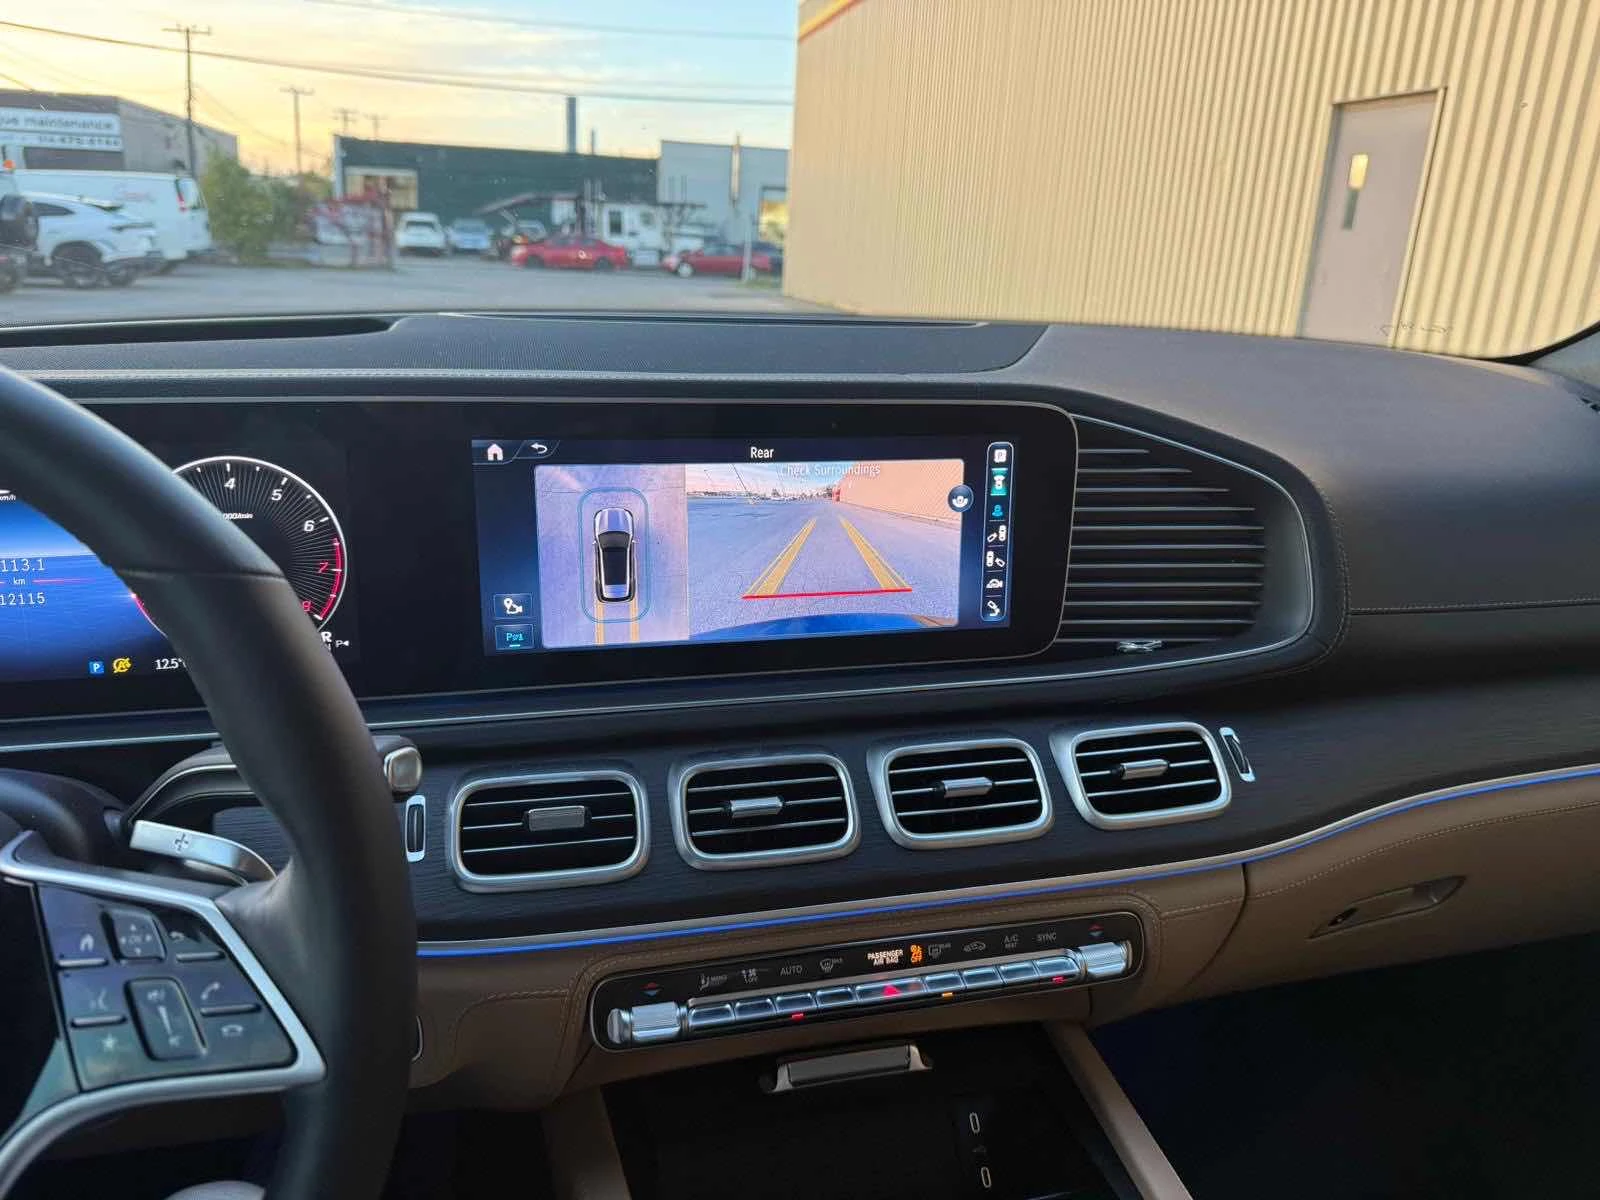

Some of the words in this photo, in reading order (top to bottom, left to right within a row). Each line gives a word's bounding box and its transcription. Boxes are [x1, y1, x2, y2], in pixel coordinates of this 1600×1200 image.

[750, 446, 774, 459] Rear
[814, 463, 881, 476] Surroundings
[224, 478, 236, 490] 4
[271, 488, 283, 501] 5
[303, 520, 315, 532] 6
[1, 558, 46, 573] 113.1
[317, 561, 330, 574] 7
[13, 577, 26, 585] km
[320, 631, 333, 643] R
[1036, 931, 1057, 943] SYNC
[867, 949, 904, 960] PASSENGER
[780, 964, 803, 976] AUTO
